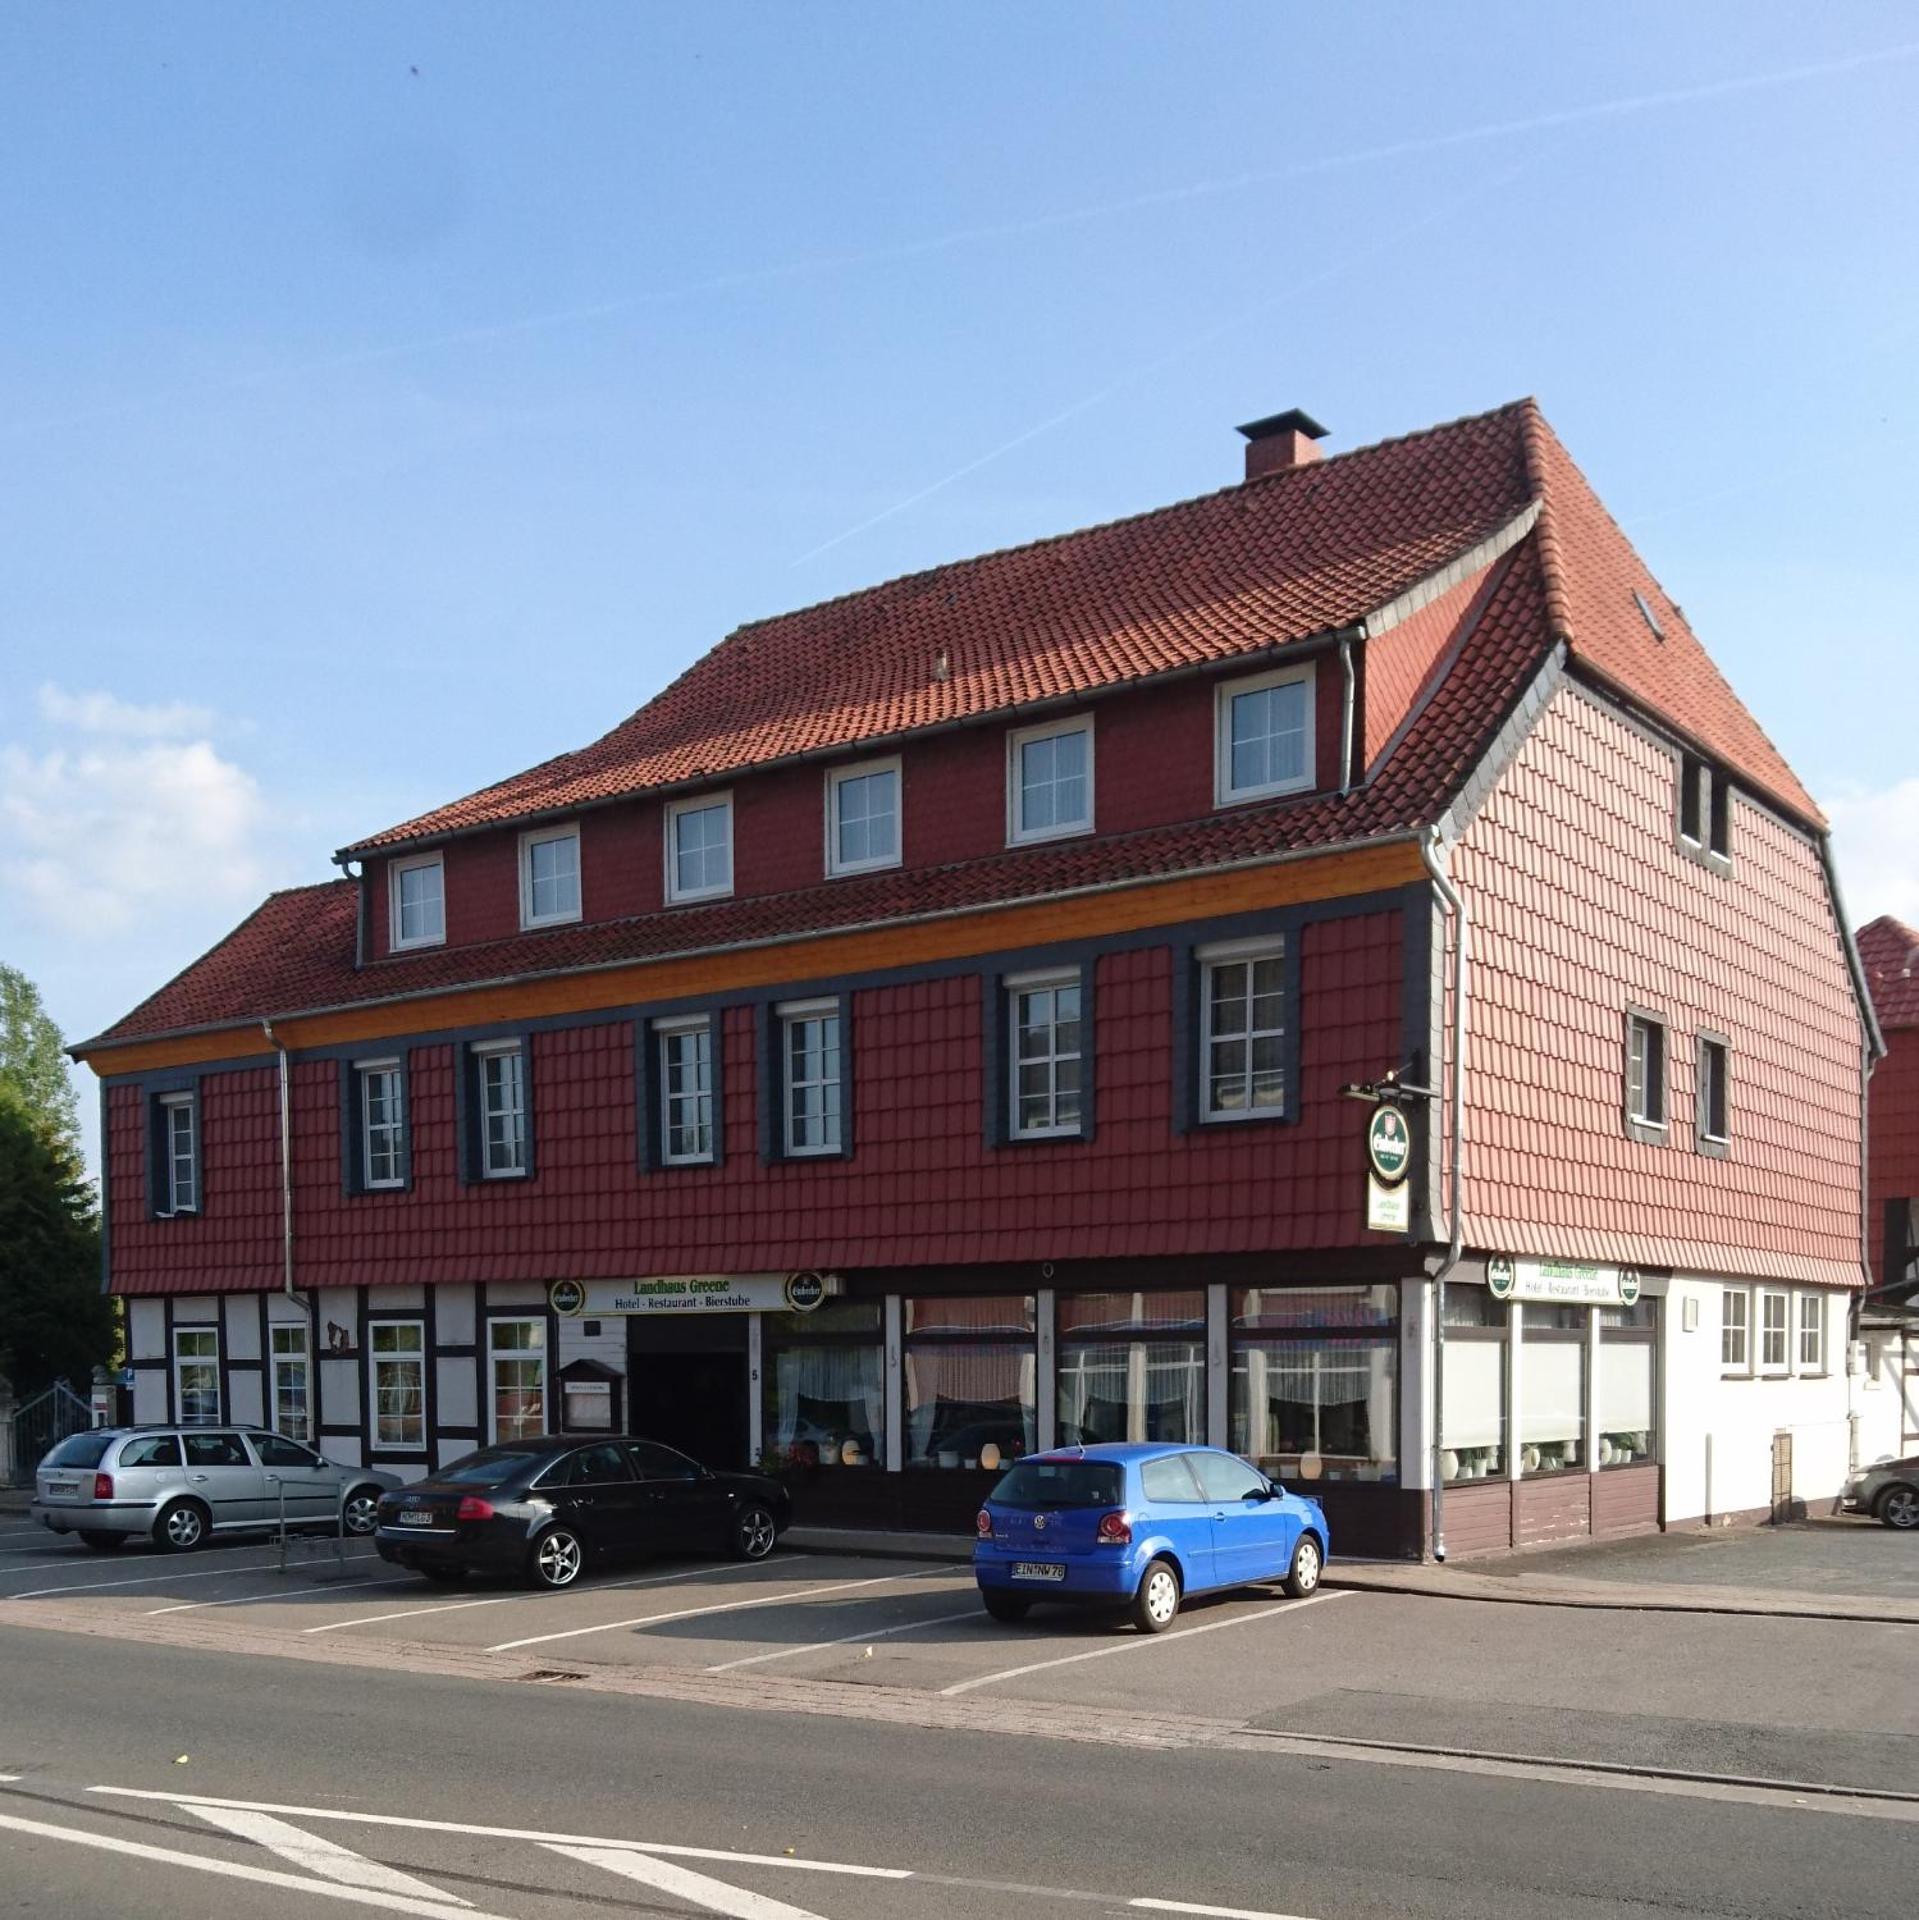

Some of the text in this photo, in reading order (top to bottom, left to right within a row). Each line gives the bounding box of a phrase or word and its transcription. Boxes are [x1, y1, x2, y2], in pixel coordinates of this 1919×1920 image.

[634, 1279, 729, 1294] Landhaus Greene
[615, 1297, 640, 1309] Hotel
[648, 1297, 696, 1309] Restaurant
[705, 1294, 750, 1307] Bierstube
[752, 1369, 758, 1381] 5
